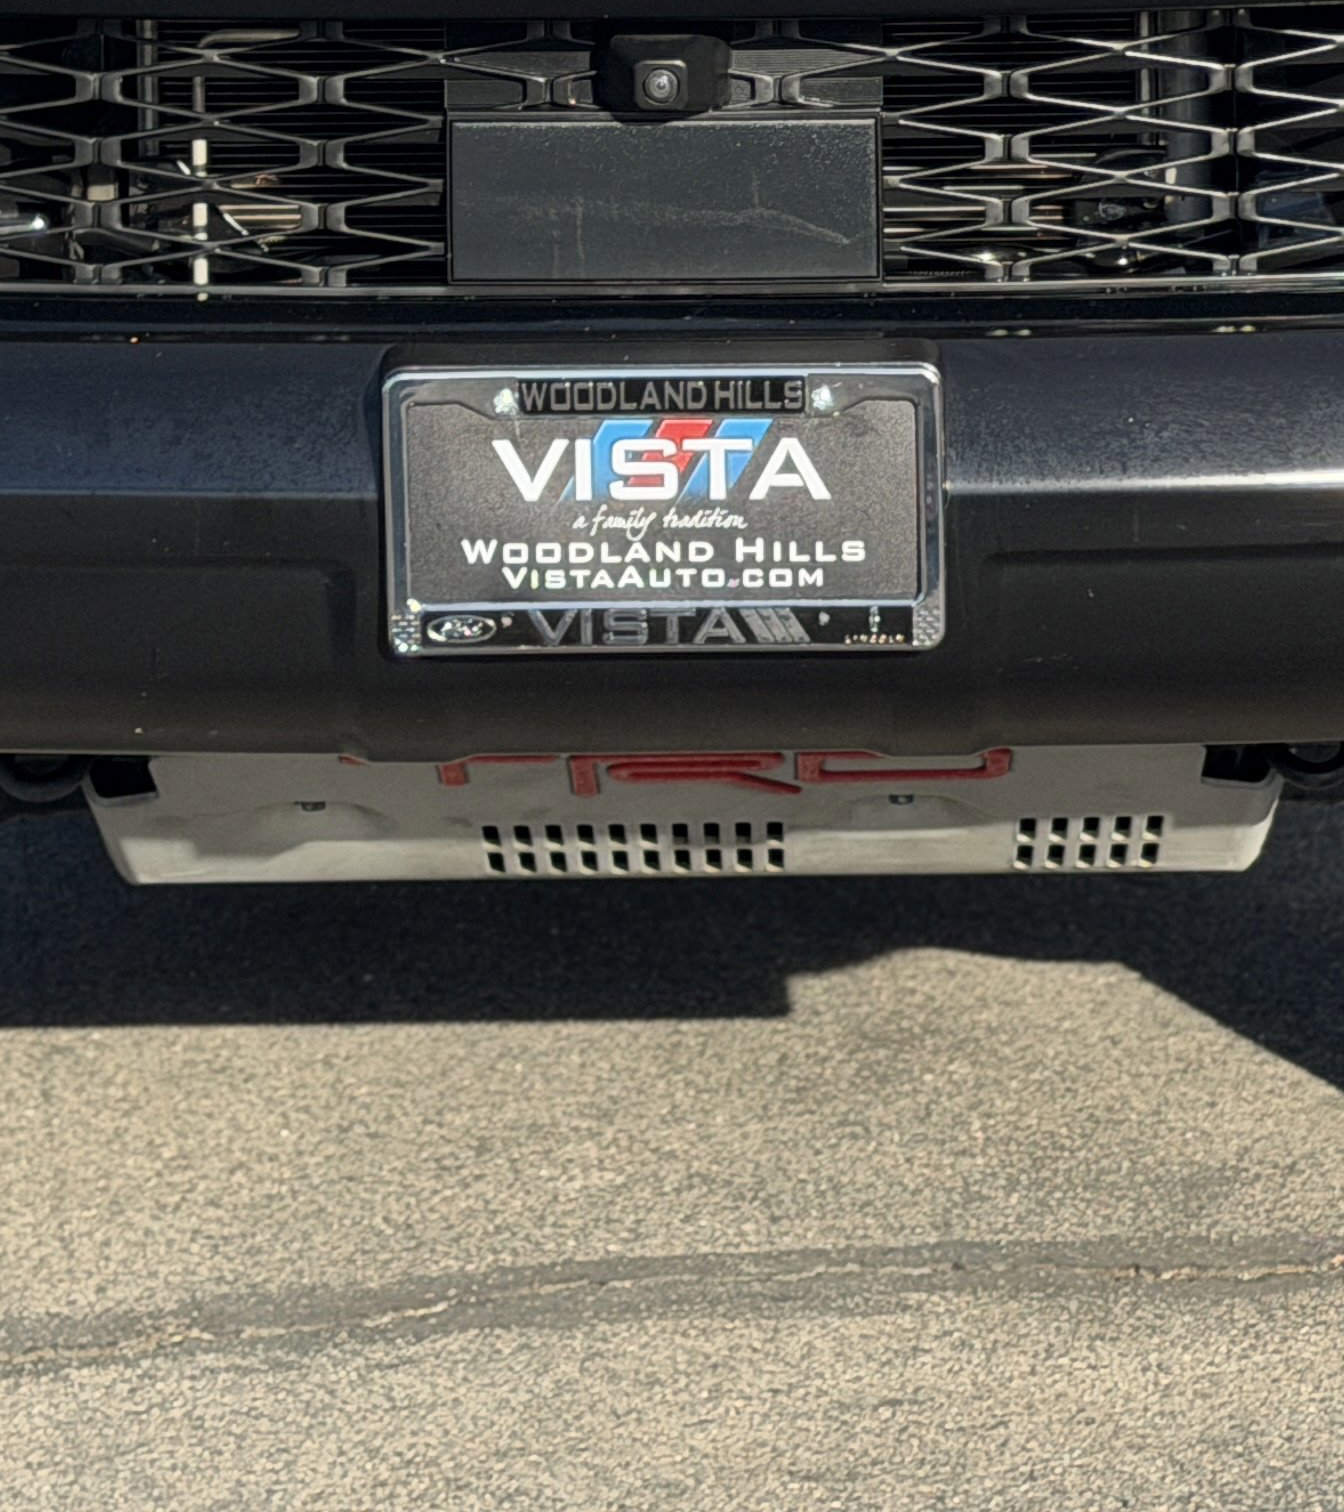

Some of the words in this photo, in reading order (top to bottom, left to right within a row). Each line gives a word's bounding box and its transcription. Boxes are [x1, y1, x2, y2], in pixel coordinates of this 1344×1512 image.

[521, 381, 707, 411] WOODLAND
[713, 380, 803, 410] HILLS
[491, 437, 832, 501] VISTA
[572, 515, 588, 529] a
[589, 504, 657, 542] family
[662, 506, 748, 529] tradition
[460, 539, 715, 565] WOODLAND
[735, 537, 867, 564] HILLS
[501, 565, 824, 589] VISTAAUTO.COM
[527, 607, 746, 646] VISTA
